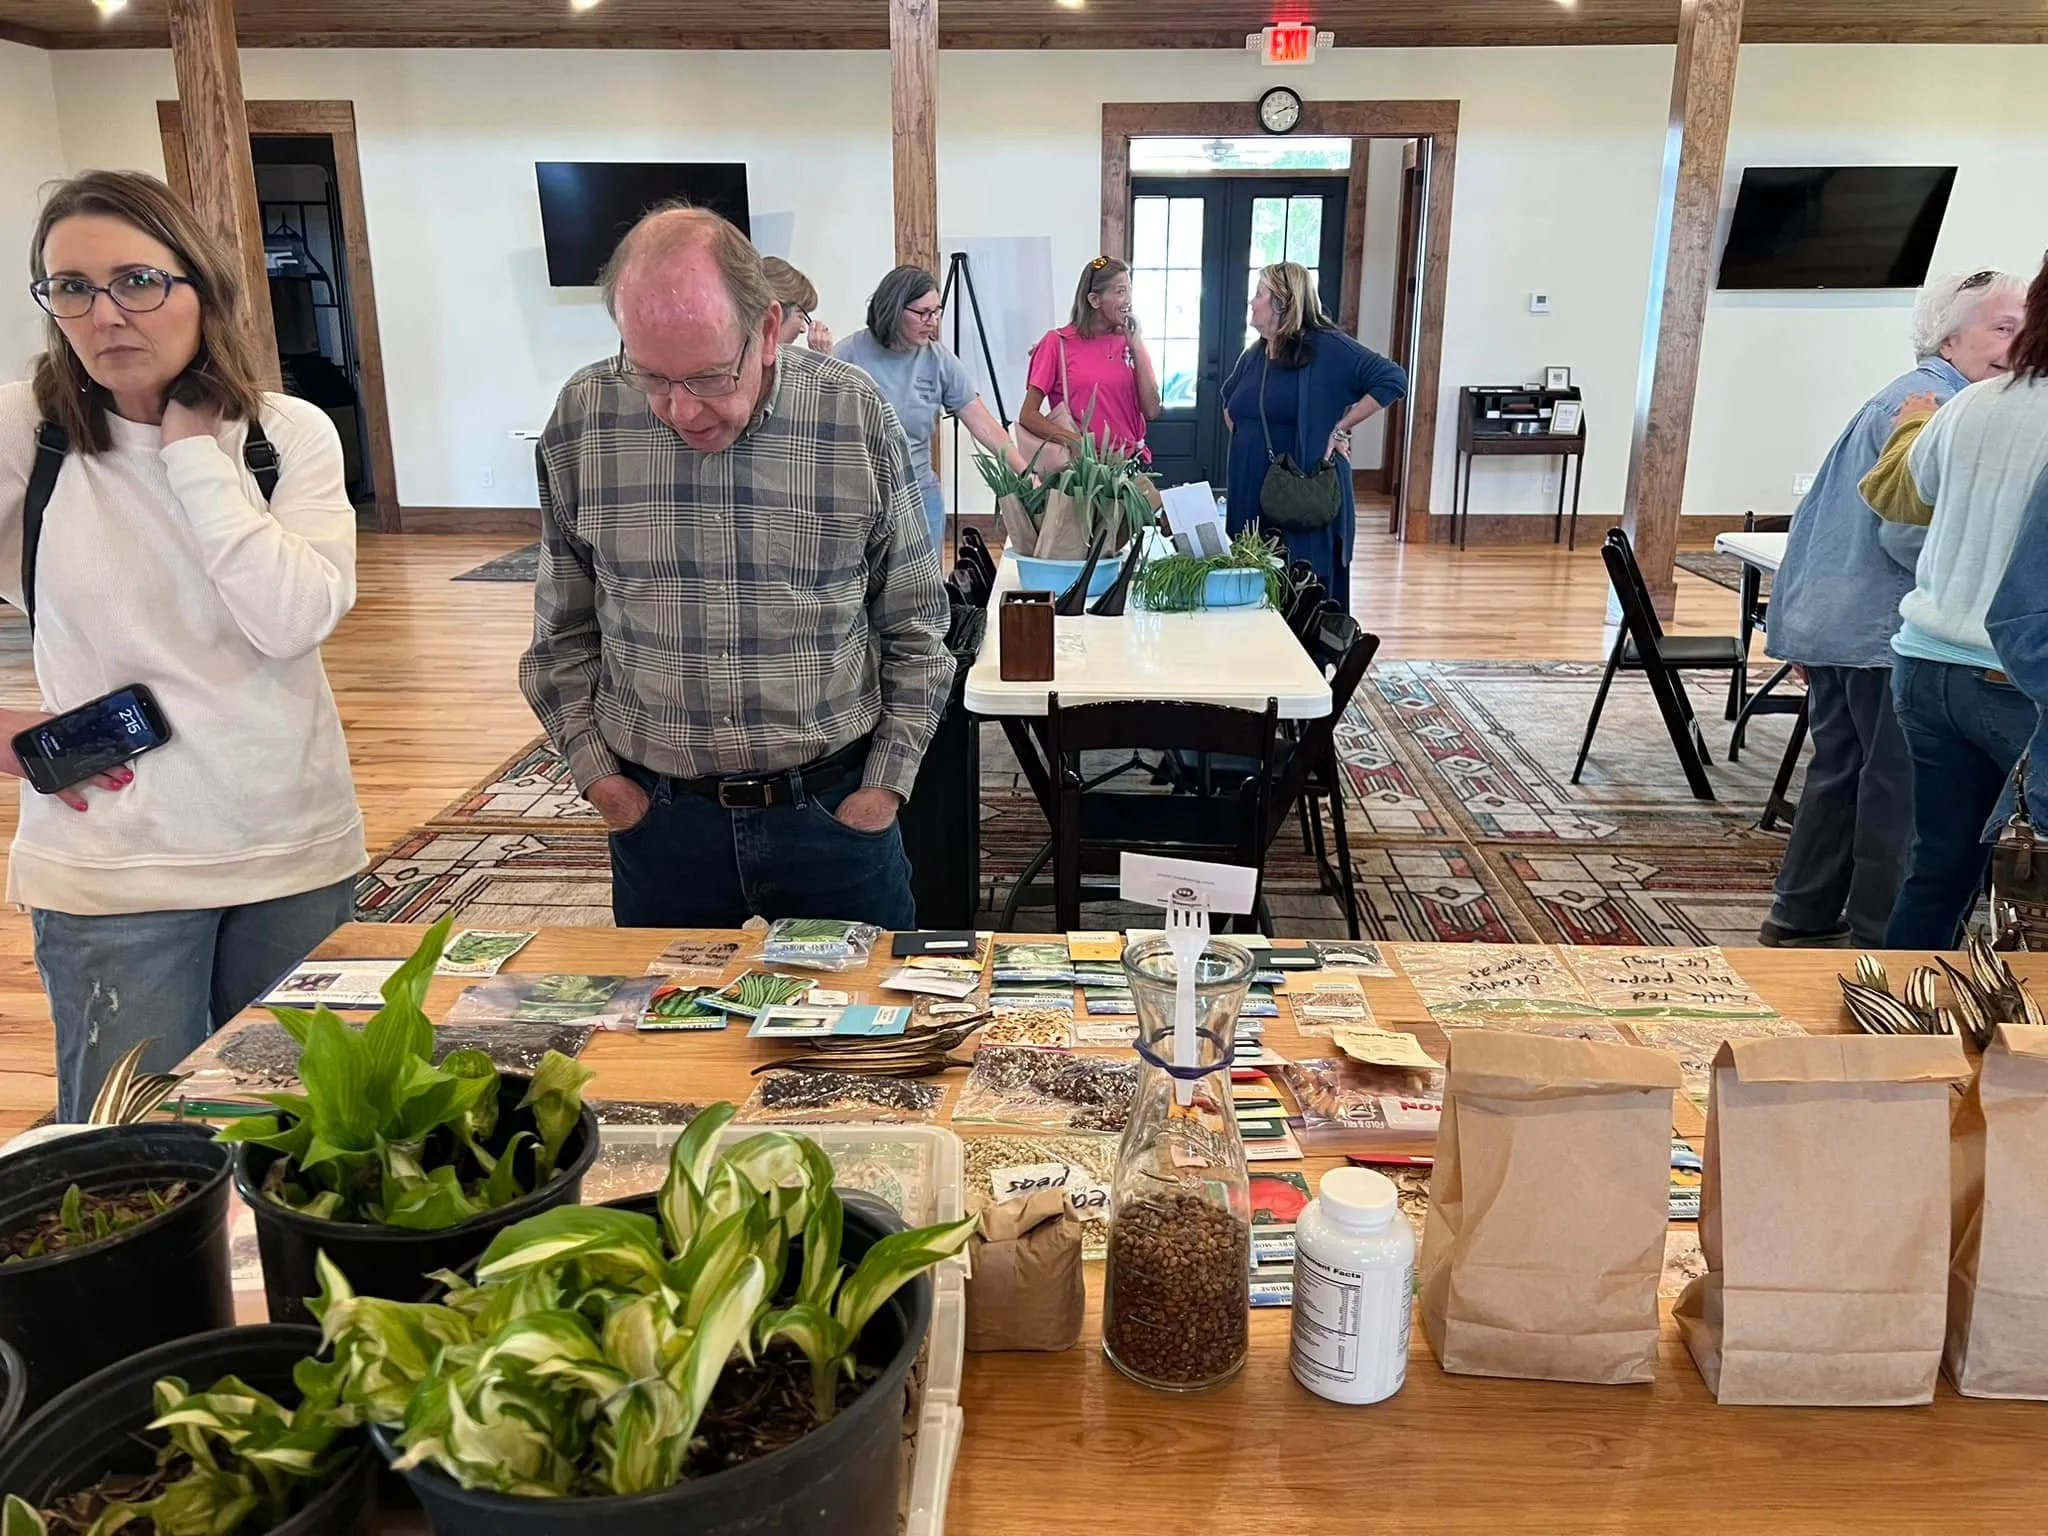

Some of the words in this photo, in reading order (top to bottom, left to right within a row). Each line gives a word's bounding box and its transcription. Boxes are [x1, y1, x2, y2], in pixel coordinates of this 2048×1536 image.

[1271, 30, 1308, 60] EXIT
[118, 708, 141, 734] 2:15
[1604, 972, 1674, 984] pepper
[1688, 974, 1733, 986] bell
[1631, 991, 1669, 1002] red
[1364, 1120, 1385, 1129] FOLD
[1005, 1167, 1070, 1193] peas
[1333, 1267, 1361, 1279] Facts
